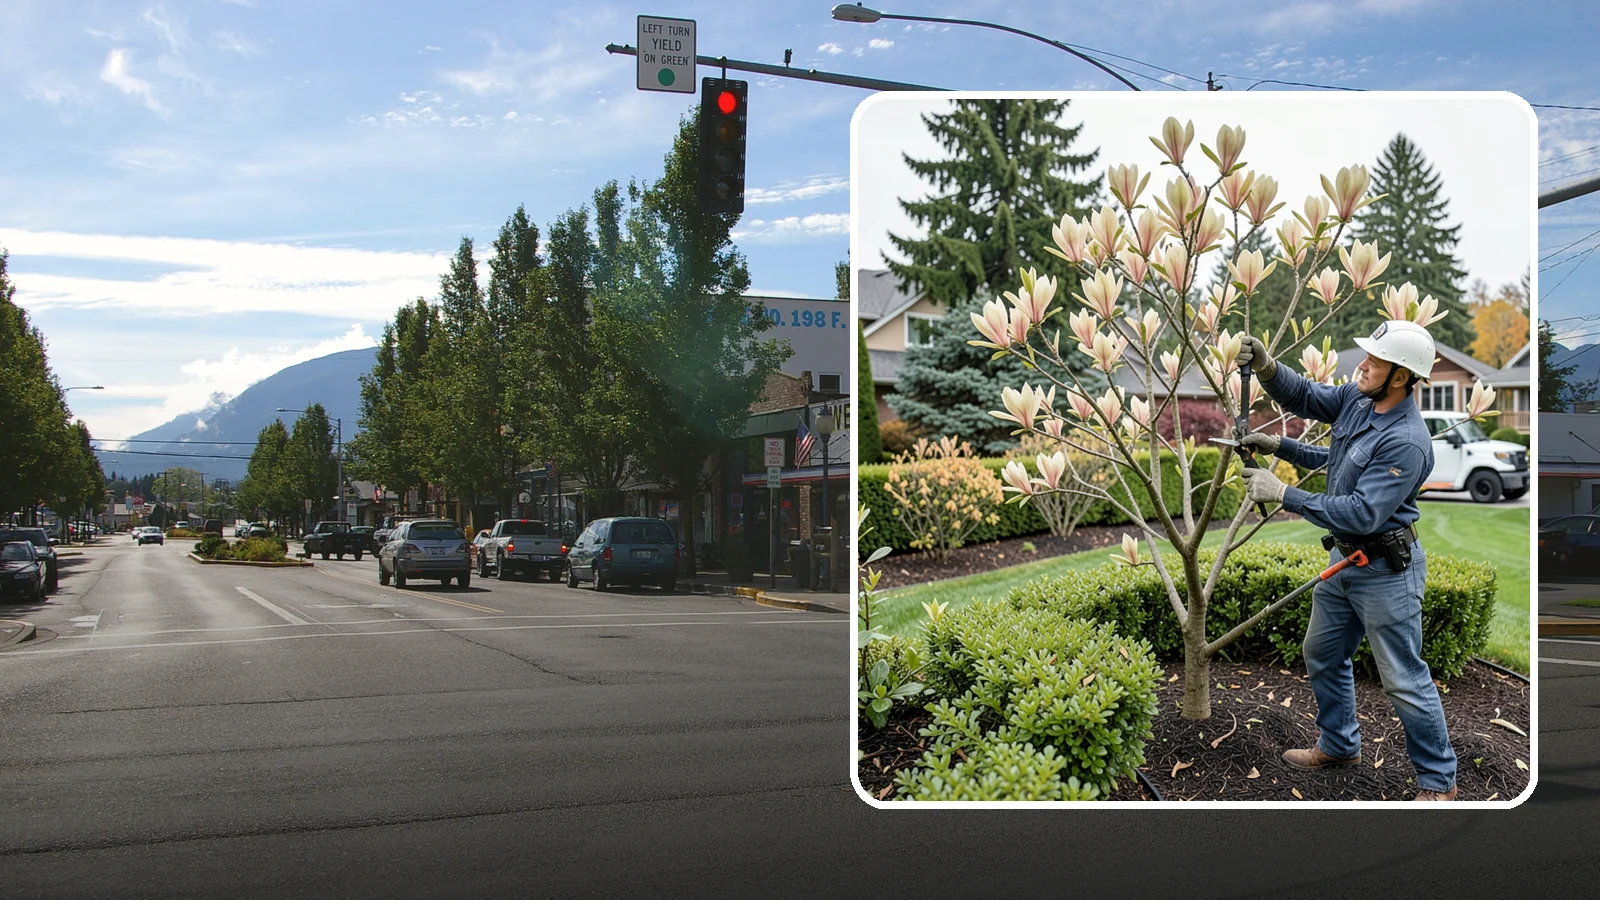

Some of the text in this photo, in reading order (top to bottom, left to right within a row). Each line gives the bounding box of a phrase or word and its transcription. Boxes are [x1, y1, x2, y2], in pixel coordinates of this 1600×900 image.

[643, 24, 690, 36] LEFT TURN
[652, 38, 682, 51] YIELD
[644, 53, 689, 66] ON GREEN
[791, 309, 826, 328] 198
[831, 311, 847, 329] F.
